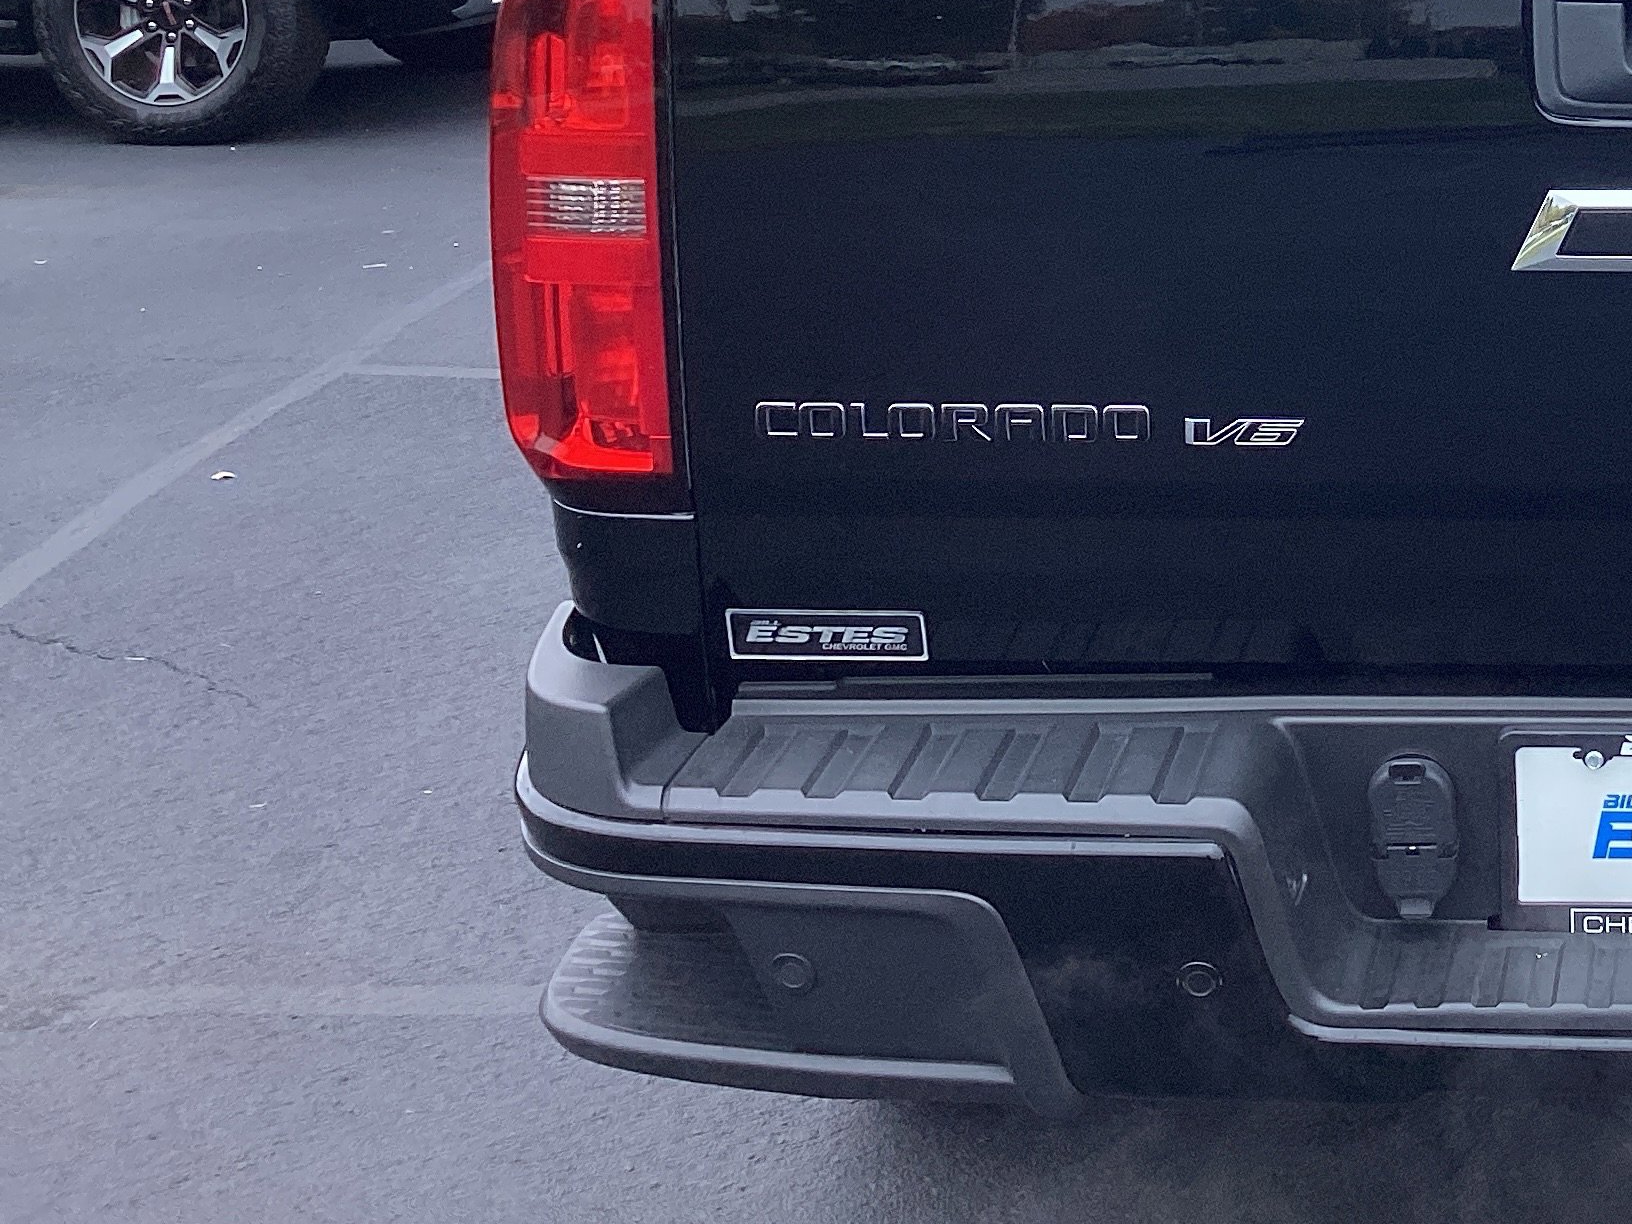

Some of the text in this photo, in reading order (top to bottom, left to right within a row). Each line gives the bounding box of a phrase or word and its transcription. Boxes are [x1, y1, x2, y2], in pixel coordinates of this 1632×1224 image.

[754, 401, 1305, 446] COLORADO V6
[746, 626, 909, 644] ESTES
[822, 643, 908, 651] CHEVROLET GMC
